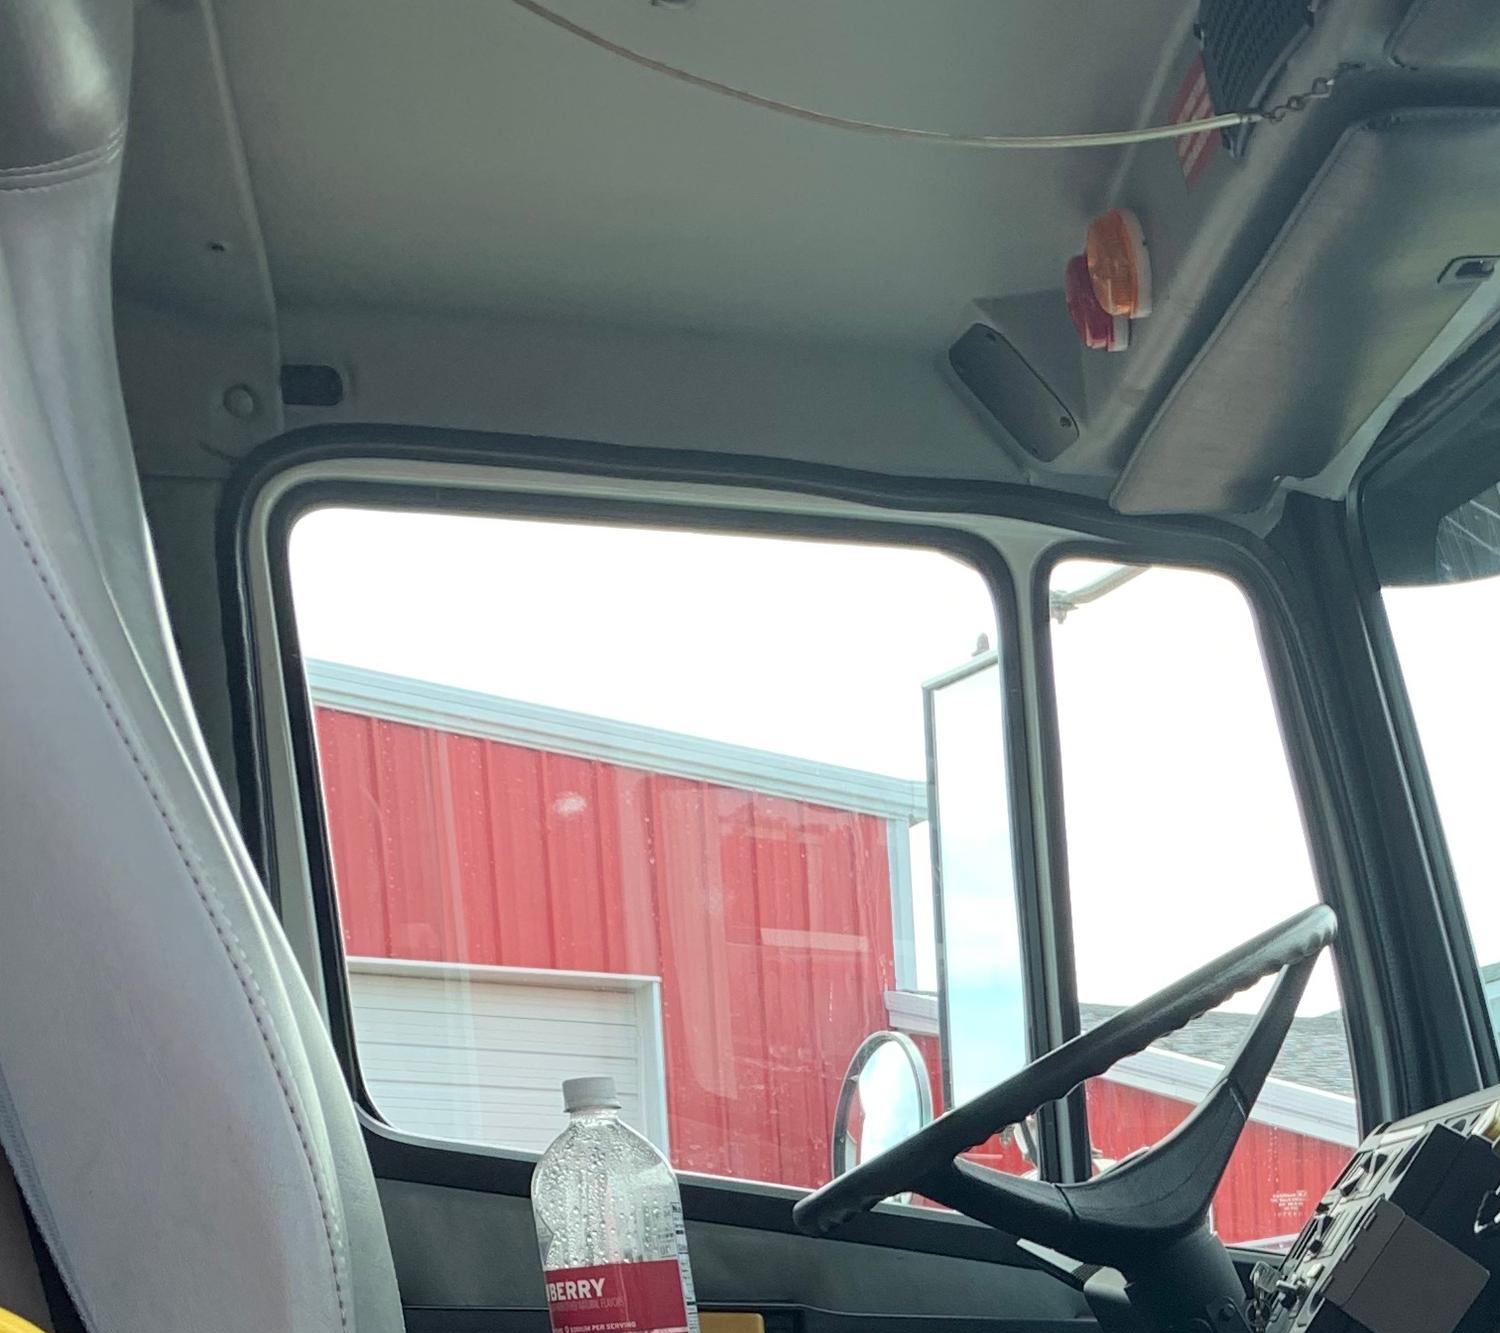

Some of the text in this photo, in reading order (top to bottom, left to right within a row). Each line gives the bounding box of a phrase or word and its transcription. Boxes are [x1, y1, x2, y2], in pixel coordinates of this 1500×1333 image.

[546, 1278, 605, 1302] BERRY
[592, 1322, 606, 1331] PER
[607, 1321, 637, 1330] SERVING
